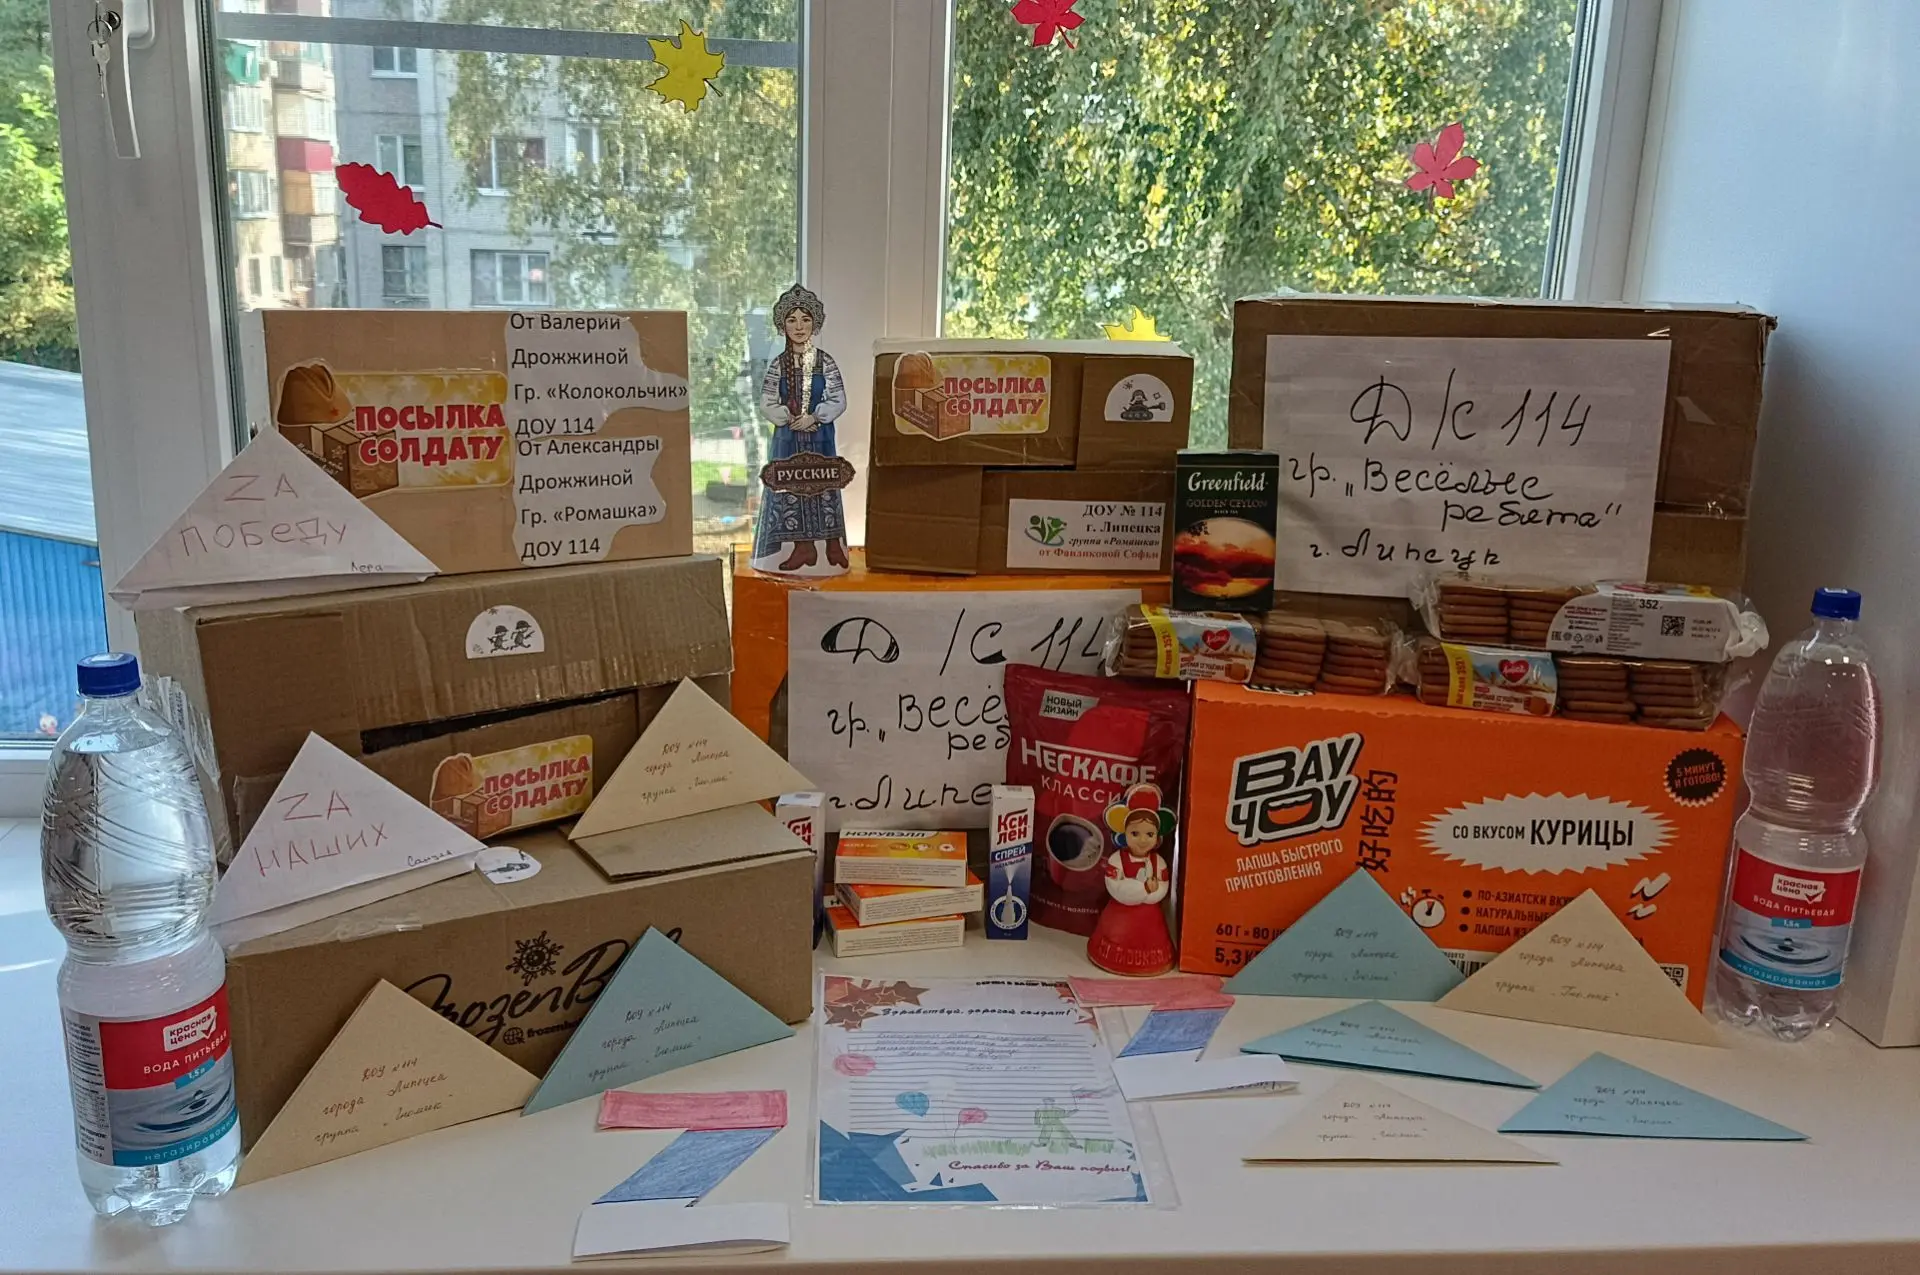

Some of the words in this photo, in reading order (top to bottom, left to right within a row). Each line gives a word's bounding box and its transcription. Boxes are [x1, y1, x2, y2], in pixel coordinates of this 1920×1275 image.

[510, 314, 533, 330] От
[540, 313, 620, 333] Валерии
[512, 348, 628, 368] Дрожжиной
[515, 384, 540, 402] Гр.
[547, 383, 688, 400] «Колокольчик»
[944, 376, 1047, 396] ПОСЫЛКА
[945, 397, 1044, 418] СОЛДАТУ
[1500, 388, 1592, 447] 114
[355, 404, 506, 434] ПОСЫЛКА
[515, 419, 558, 438] ДОУ
[563, 416, 595, 434] 114
[358, 436, 504, 466] СОЛДАТУ
[519, 440, 542, 456] От
[548, 438, 660, 457] Александры
[520, 472, 633, 493] Дрожжиной
[776, 467, 840, 482] РУССКИЕ
[1188, 471, 1266, 492] Greenfield
[521, 508, 547, 526] Гр.
[554, 502, 657, 522] «Ромашка»
[1082, 504, 1117, 518] ДОУ
[1120, 506, 1136, 516] №
[1140, 506, 1163, 517] 114
[1186, 500, 1227, 508] GOLDEN
[1229, 500, 1268, 508] CEYLON
[1086, 524, 1096, 532] г.
[1100, 522, 1161, 535] Липецка
[521, 542, 562, 561] ДОУ
[569, 538, 600, 555] 114
[1068, 538, 1101, 548] группа
[1104, 538, 1160, 547] «Ромашка»
[1639, 598, 1658, 610] 352
[1044, 704, 1078, 718] ДИЗАЙН
[1046, 696, 1082, 708] НОВЫЙ
[1021, 737, 1156, 786] НЕСКАФЕ
[1234, 737, 1356, 800] ВАУ
[1676, 767, 1683, 778] 5
[1684, 762, 1715, 776] МИНУТ
[484, 756, 590, 794] ПОСЫЛКА
[1683, 772, 1720, 787] ГОТОВО!
[486, 778, 588, 814] СОЛДАТУ
[1042, 775, 1122, 804] КЛАССИ
[1231, 780, 1353, 839] ЧОУ
[1356, 770, 1398, 873] 好吃的
[997, 826, 1028, 845] лен
[1453, 826, 1468, 839] СО
[1473, 825, 1526, 839] ВКУСОМ
[1530, 820, 1634, 850] КУРИЦЫ
[994, 844, 1026, 861] СПРЕЙ
[1236, 851, 1281, 873] ЛАПША
[1282, 838, 1344, 864] БЫСТРОГО
[1226, 861, 1322, 893] ПРИГОТОВЛЕНИЯ
[1777, 878, 1818, 891] красная
[1478, 890, 1546, 906] ПО-АЗИАТСКИ
[1776, 885, 1800, 896] цена
[1753, 895, 1780, 910] ВОДА
[1783, 904, 1836, 918] ПИТЬЕВАЯ
[1216, 924, 1232, 936] 60
[1252, 927, 1270, 940] 80
[1474, 924, 1511, 937] ЛАПША
[1215, 947, 1242, 966] 5,3
[169, 1012, 212, 1038] красная
[170, 1029, 197, 1046] цена
[143, 1058, 180, 1075] ВОДА
[184, 1030, 228, 1064] ПИТЬЕВАЯ
[322, 1095, 366, 1120] города
[386, 1073, 450, 1097] Липецка
[314, 1126, 360, 1146] группа
[948, 1160, 1012, 1170] Спасибо
[1036, 1160, 1076, 1171] Ваш
[1080, 1164, 1131, 1175] подвиг!
